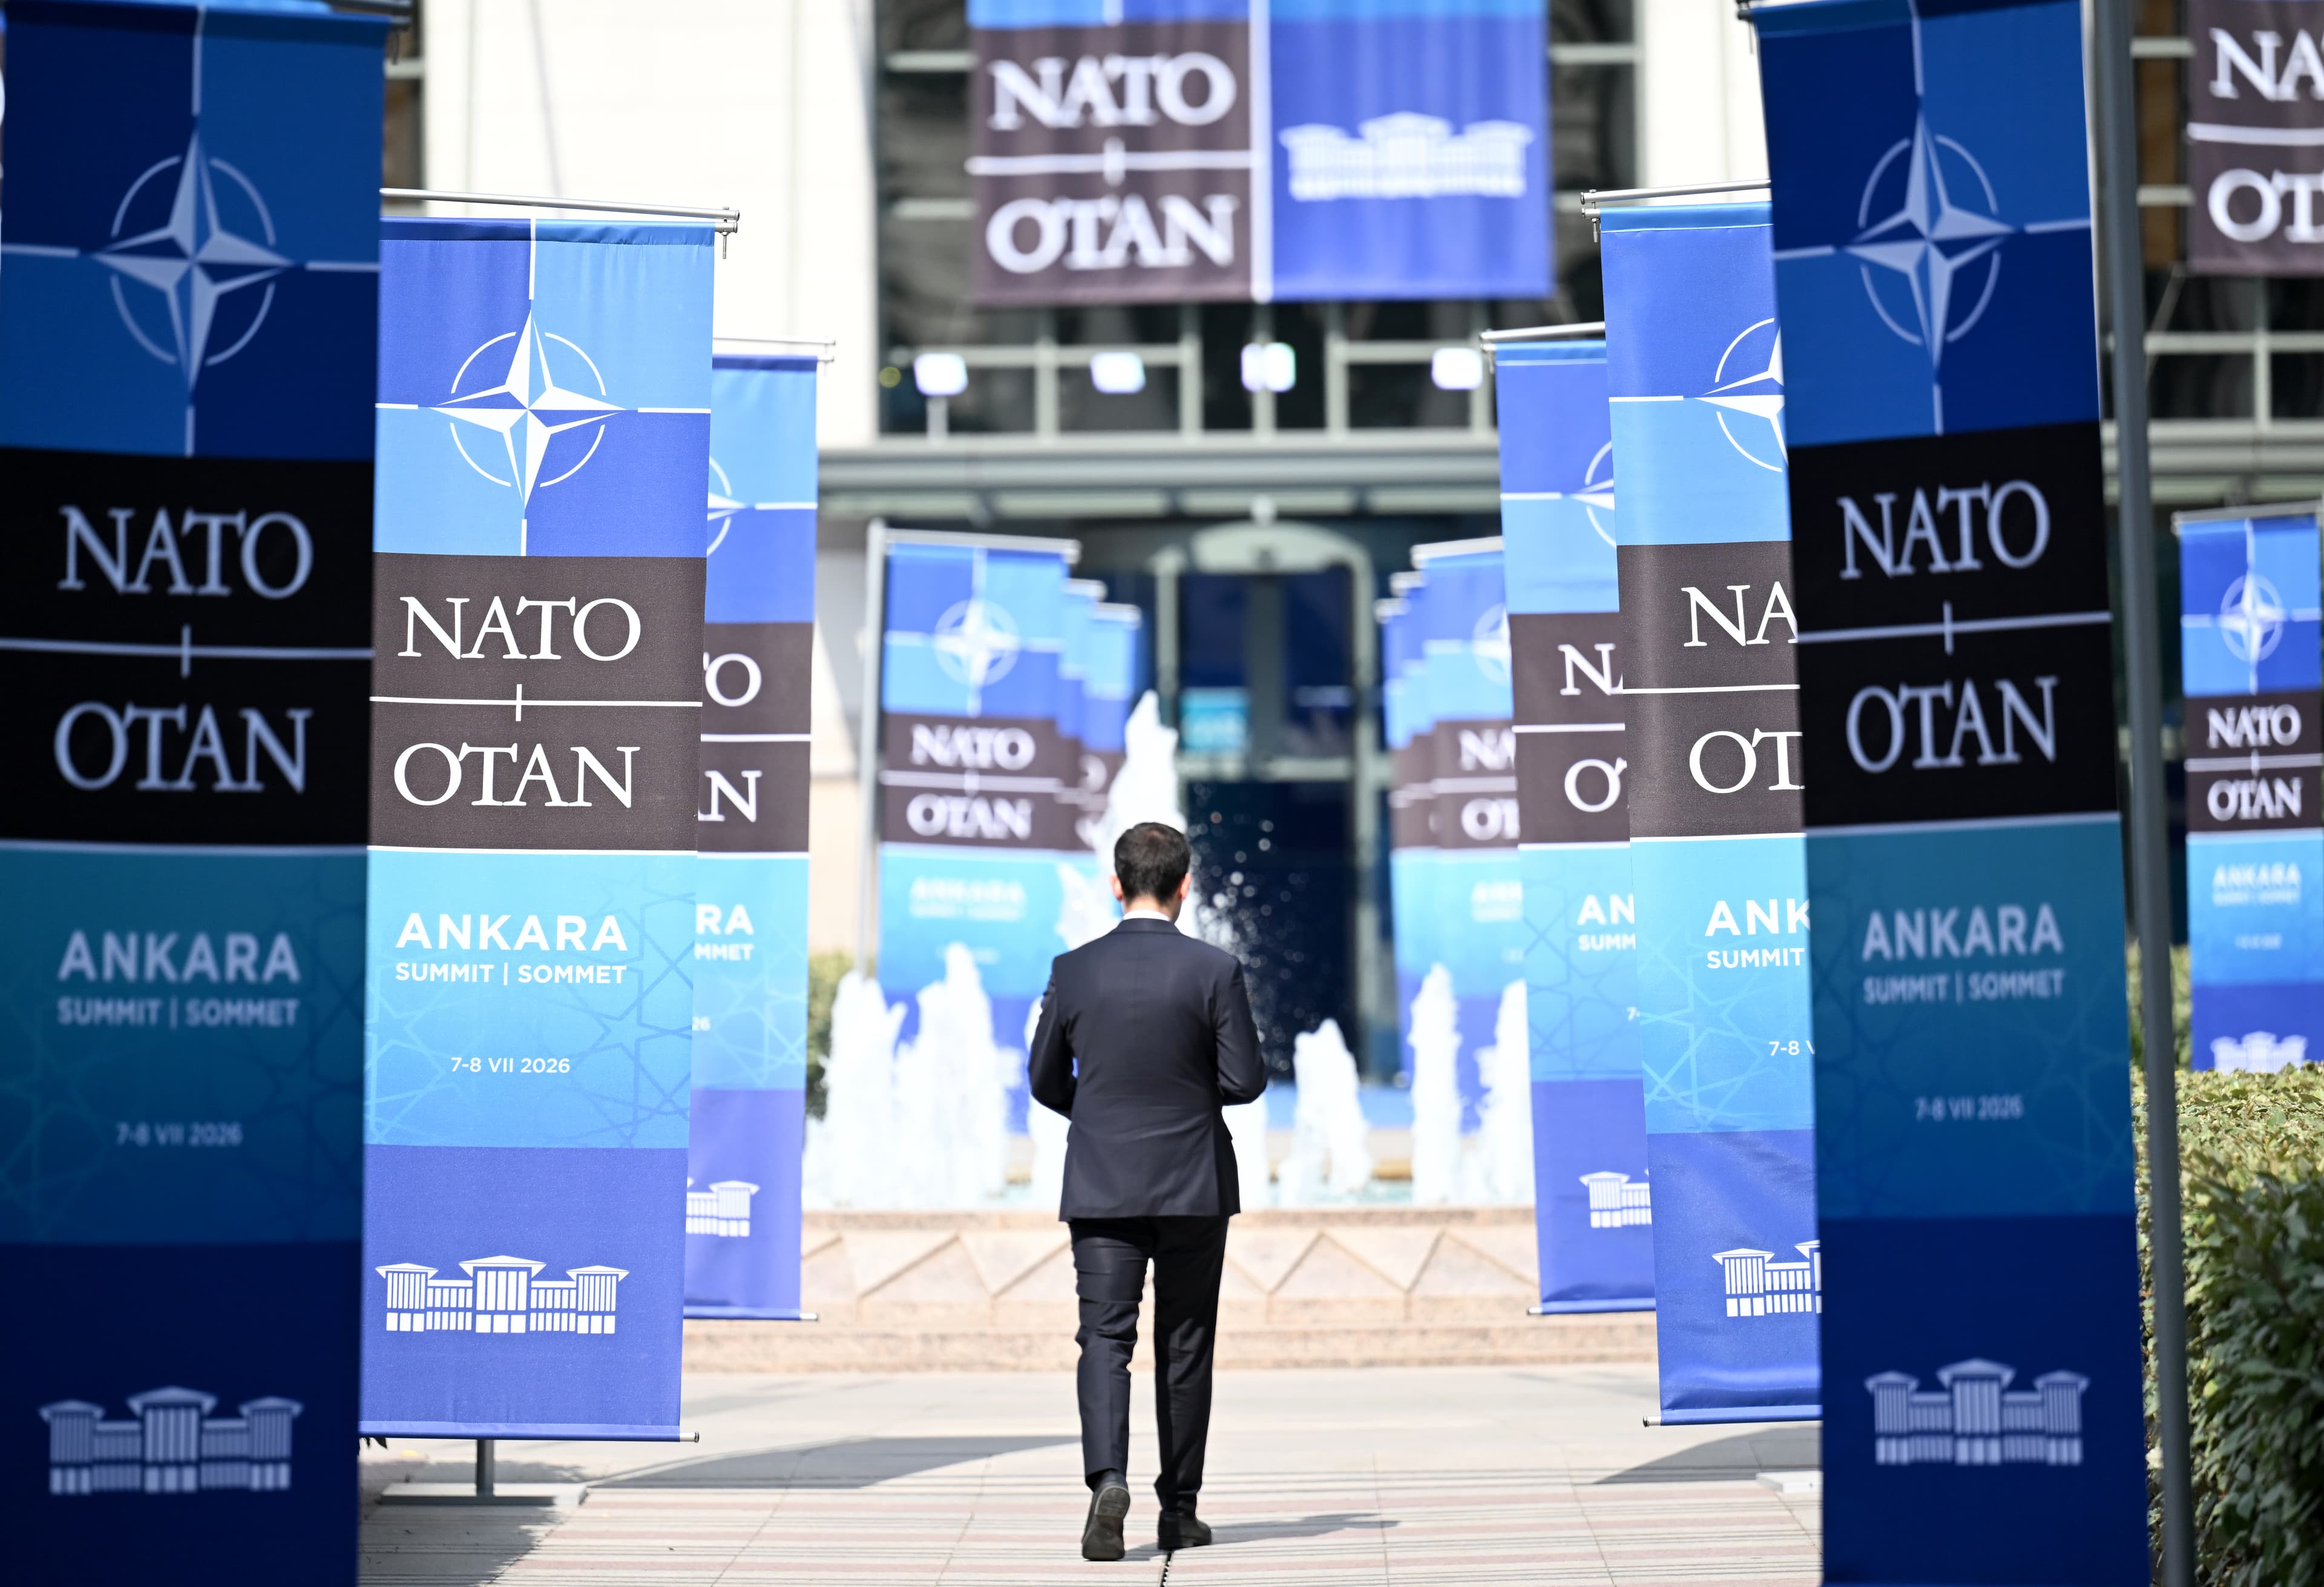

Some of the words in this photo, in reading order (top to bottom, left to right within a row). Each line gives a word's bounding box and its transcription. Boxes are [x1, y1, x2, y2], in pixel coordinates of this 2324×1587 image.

[2209, 27, 2324, 102] NA
[986, 52, 1237, 131] NATO
[986, 194, 1239, 273] OTAN
[58, 505, 313, 600] NATO
[1837, 480, 2051, 579] NATO
[398, 595, 642, 662] NATO
[54, 701, 313, 795] OTAN
[910, 724, 1036, 771] NATO
[1845, 675, 2058, 773] OTAN
[2206, 704, 2302, 749] NATO
[394, 742, 641, 808] OTAN
[2207, 776, 2303, 822] OTAN
[907, 793, 1032, 840] OTAN
[57, 929, 301, 983] ANKARA
[395, 912, 628, 951] ANKARA
[1862, 903, 2064, 961] ANKARA
[395, 963, 494, 983] SUMMIT
[517, 965, 627, 984] SOMMET
[1707, 947, 1805, 969] SUMMIT
[1864, 972, 1949, 1004] SUMMIT
[1968, 968, 2064, 1000] SOMMET
[57, 997, 162, 1026] SUMMIT
[185, 998, 300, 1027] SOMMET
[450, 1057, 482, 1073] 7-8
[488, 1058, 514, 1073] VII
[520, 1058, 571, 1073] 2026
[1768, 1040, 1800, 1056] 7-8
